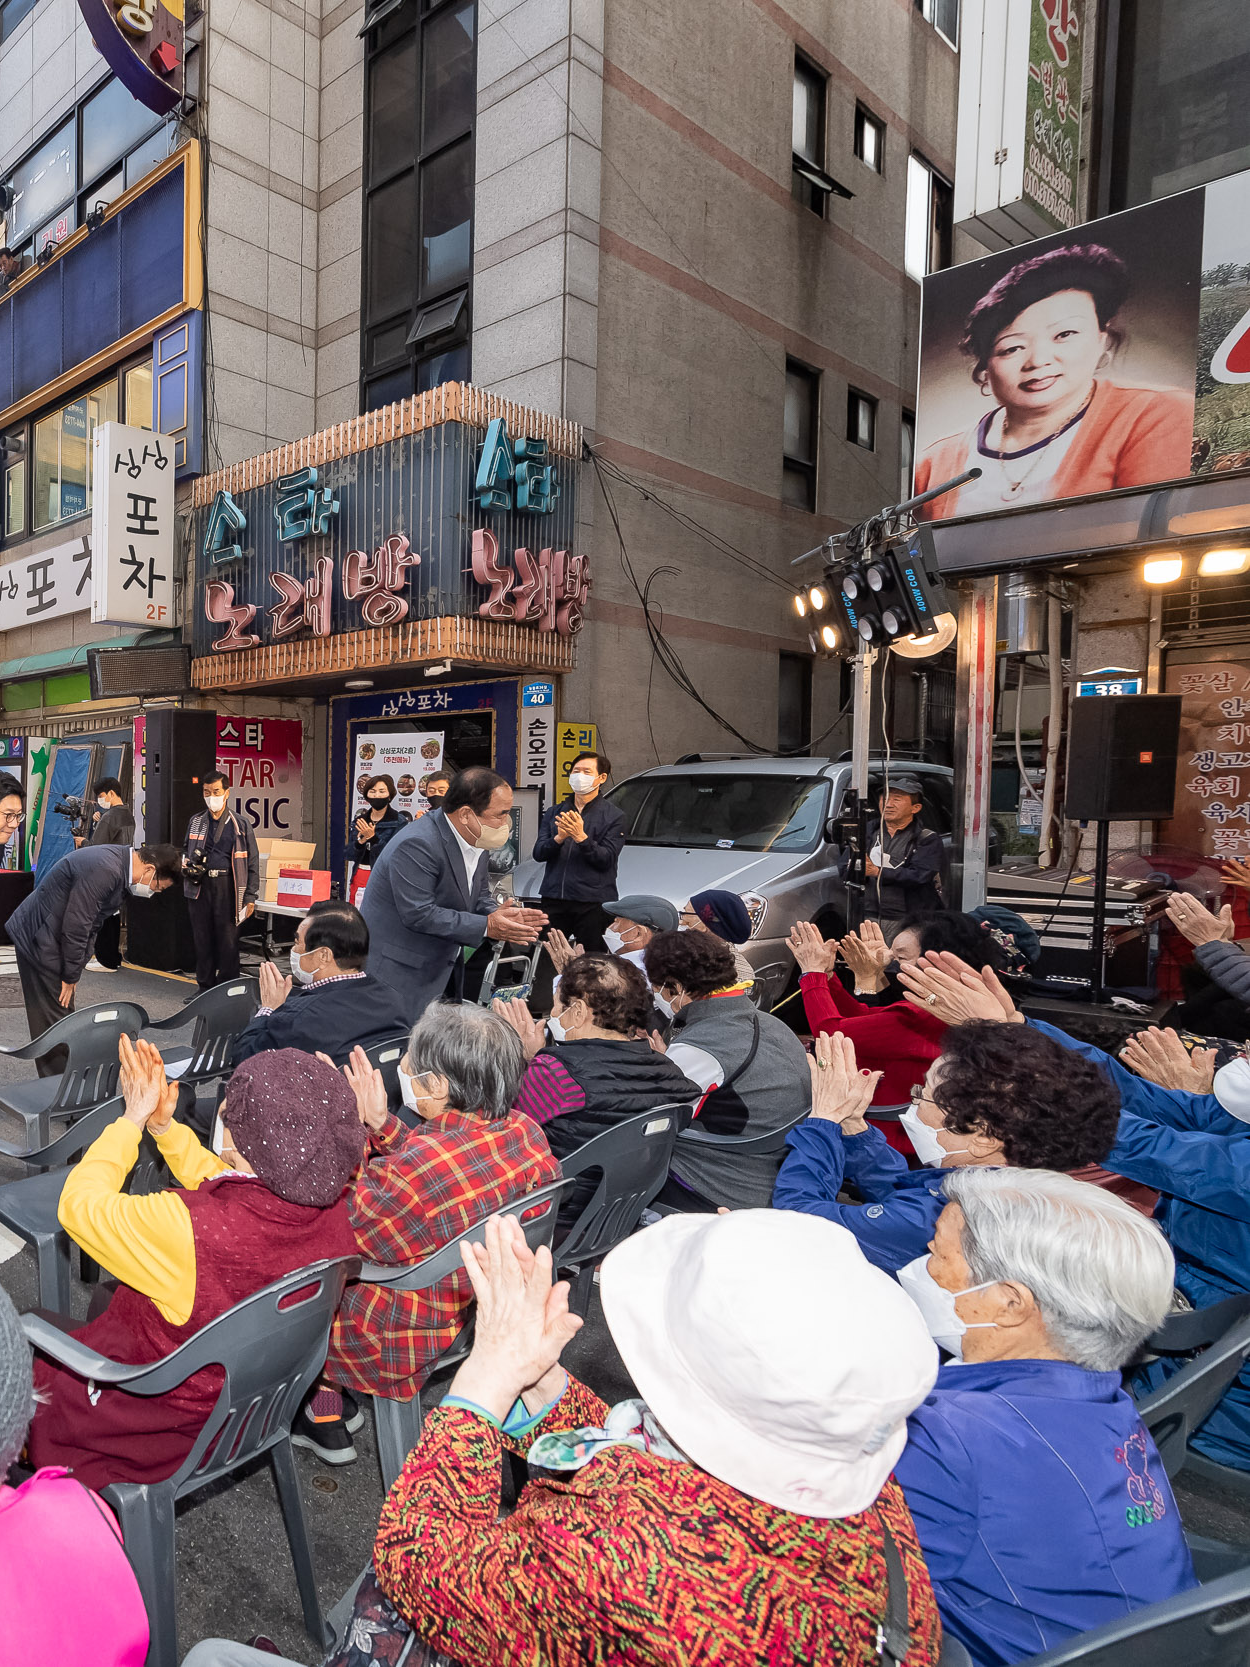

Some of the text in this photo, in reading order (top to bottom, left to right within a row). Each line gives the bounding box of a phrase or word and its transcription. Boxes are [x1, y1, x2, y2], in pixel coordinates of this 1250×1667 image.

[203, 466, 340, 566] 스타
[205, 532, 421, 652] 노래방
[471, 527, 591, 636] 노래방
[905, 569, 926, 611] 400W COB
[146, 604, 167, 621] 2F
[1095, 683, 1123, 696] 38
[1180, 672, 1235, 694] 꽃살
[381, 690, 453, 716] 상상포차
[531, 693, 545, 704] 40
[218, 721, 265, 752] 스타
[1185, 775, 1240, 798] 육회
